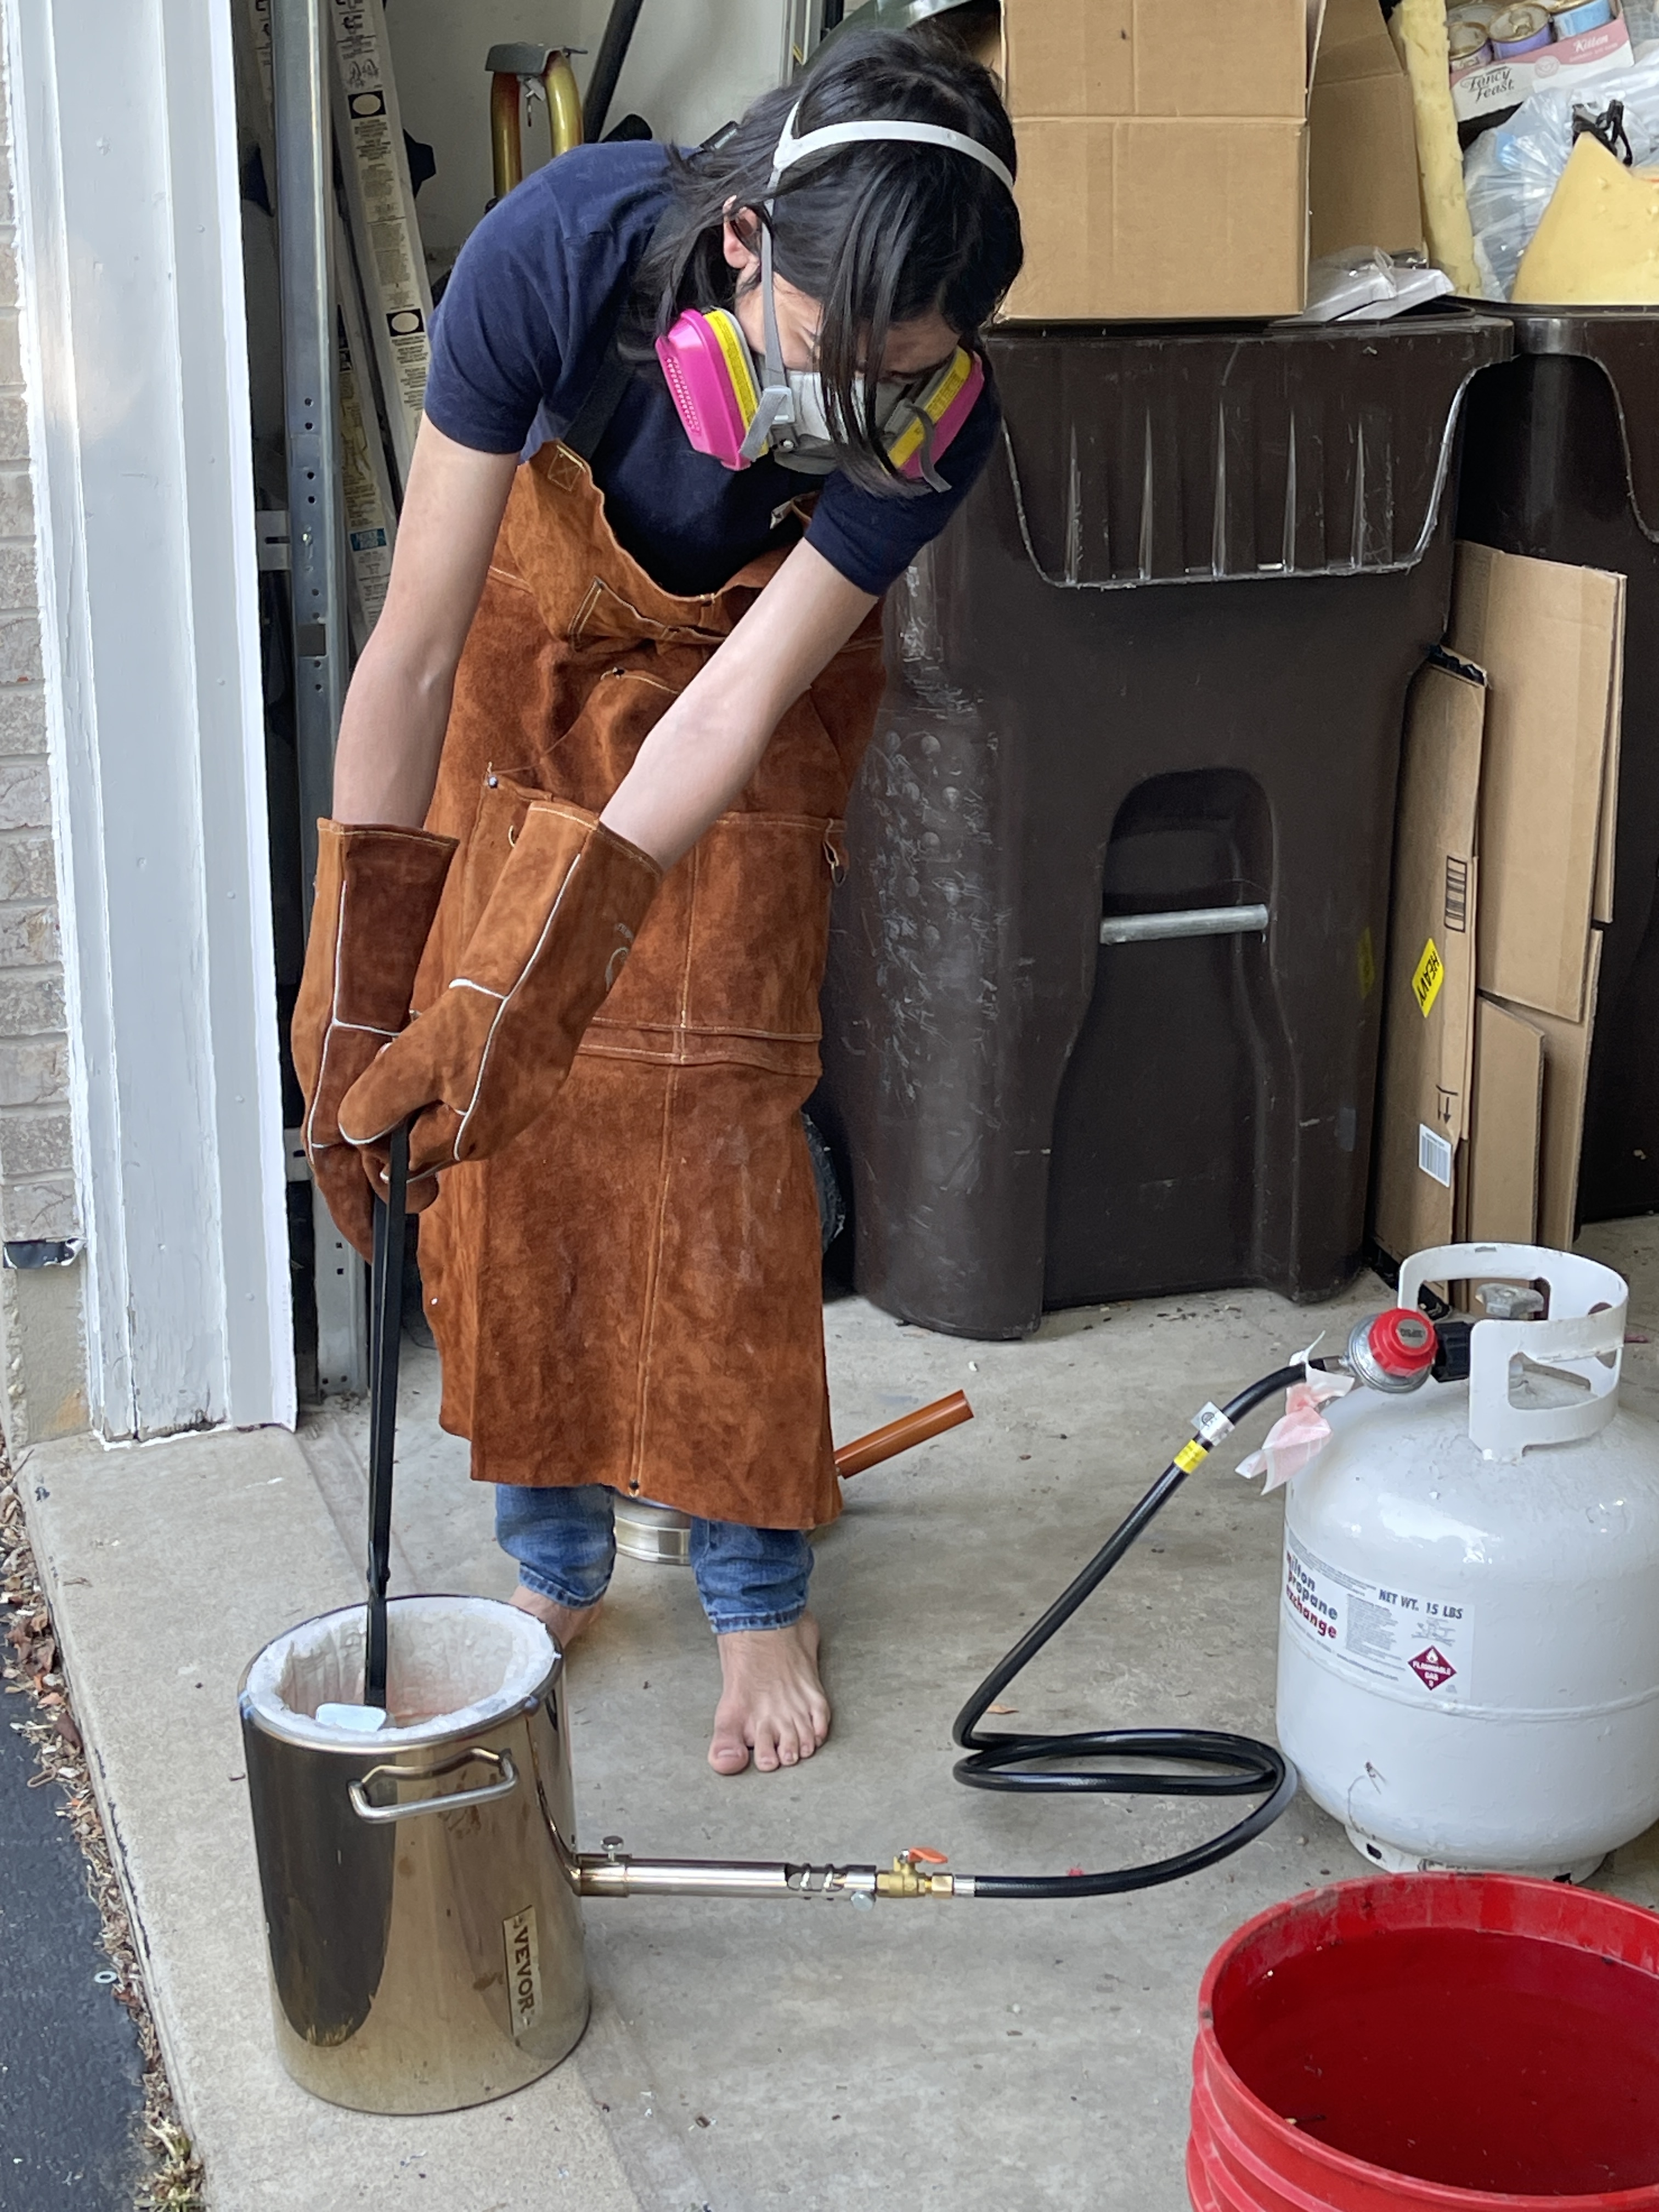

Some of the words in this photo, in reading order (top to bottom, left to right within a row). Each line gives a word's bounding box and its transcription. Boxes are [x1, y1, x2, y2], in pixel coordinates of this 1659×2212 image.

[1460, 66, 1512, 91] Fancy
[1475, 79, 1514, 102] Feast
[1417, 950, 1440, 1007] HEAVY
[1288, 1570, 1338, 1620] propane
[1379, 1589, 1398, 1605] NET
[1401, 1596, 1419, 1611] WT.
[1426, 1602, 1439, 1615] 15
[1442, 1606, 1463, 1619] LBS
[514, 1926, 535, 2014] VEVOR
